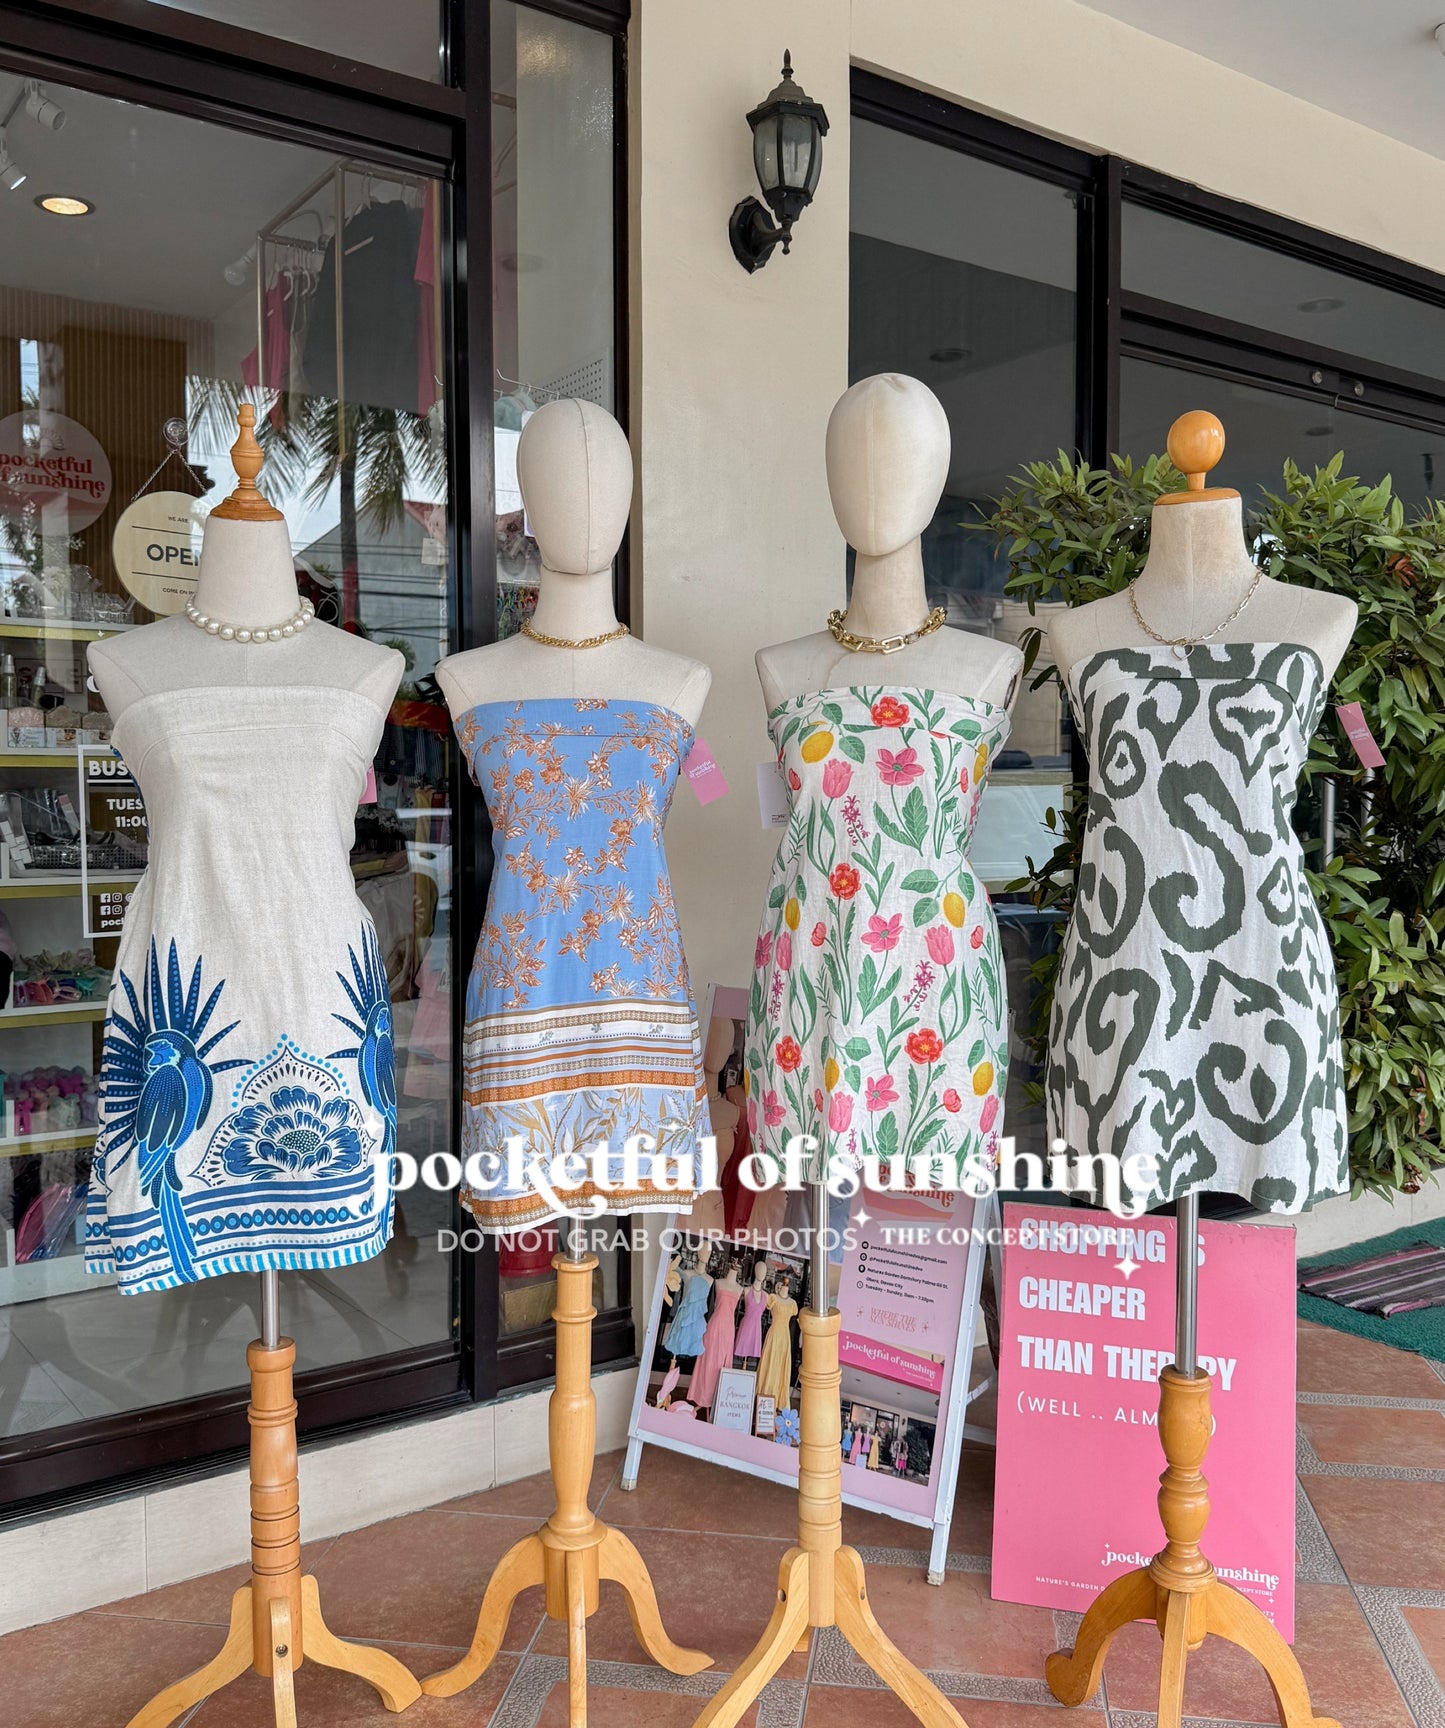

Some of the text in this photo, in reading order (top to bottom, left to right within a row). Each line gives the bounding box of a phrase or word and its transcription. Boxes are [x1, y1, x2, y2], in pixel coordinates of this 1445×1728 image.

[22, 471, 105, 498] unshine
[106, 798, 144, 811] TUES
[1020, 1217, 1166, 1263] SHOPPING
[1019, 1276, 1146, 1321] CHEAPER
[843, 1340, 890, 1360] pocketful
[890, 1355, 900, 1365] of
[900, 1359, 936, 1379] sunshine
[1017, 1335, 1237, 1391] THAN THERPY
[1017, 1391, 1081, 1418] (WELL
[1035, 1576, 1069, 1587] NATURE'S
[1070, 1581, 1099, 1592] GARDEN
[1101, 1551, 1280, 1591] pocke unshine
